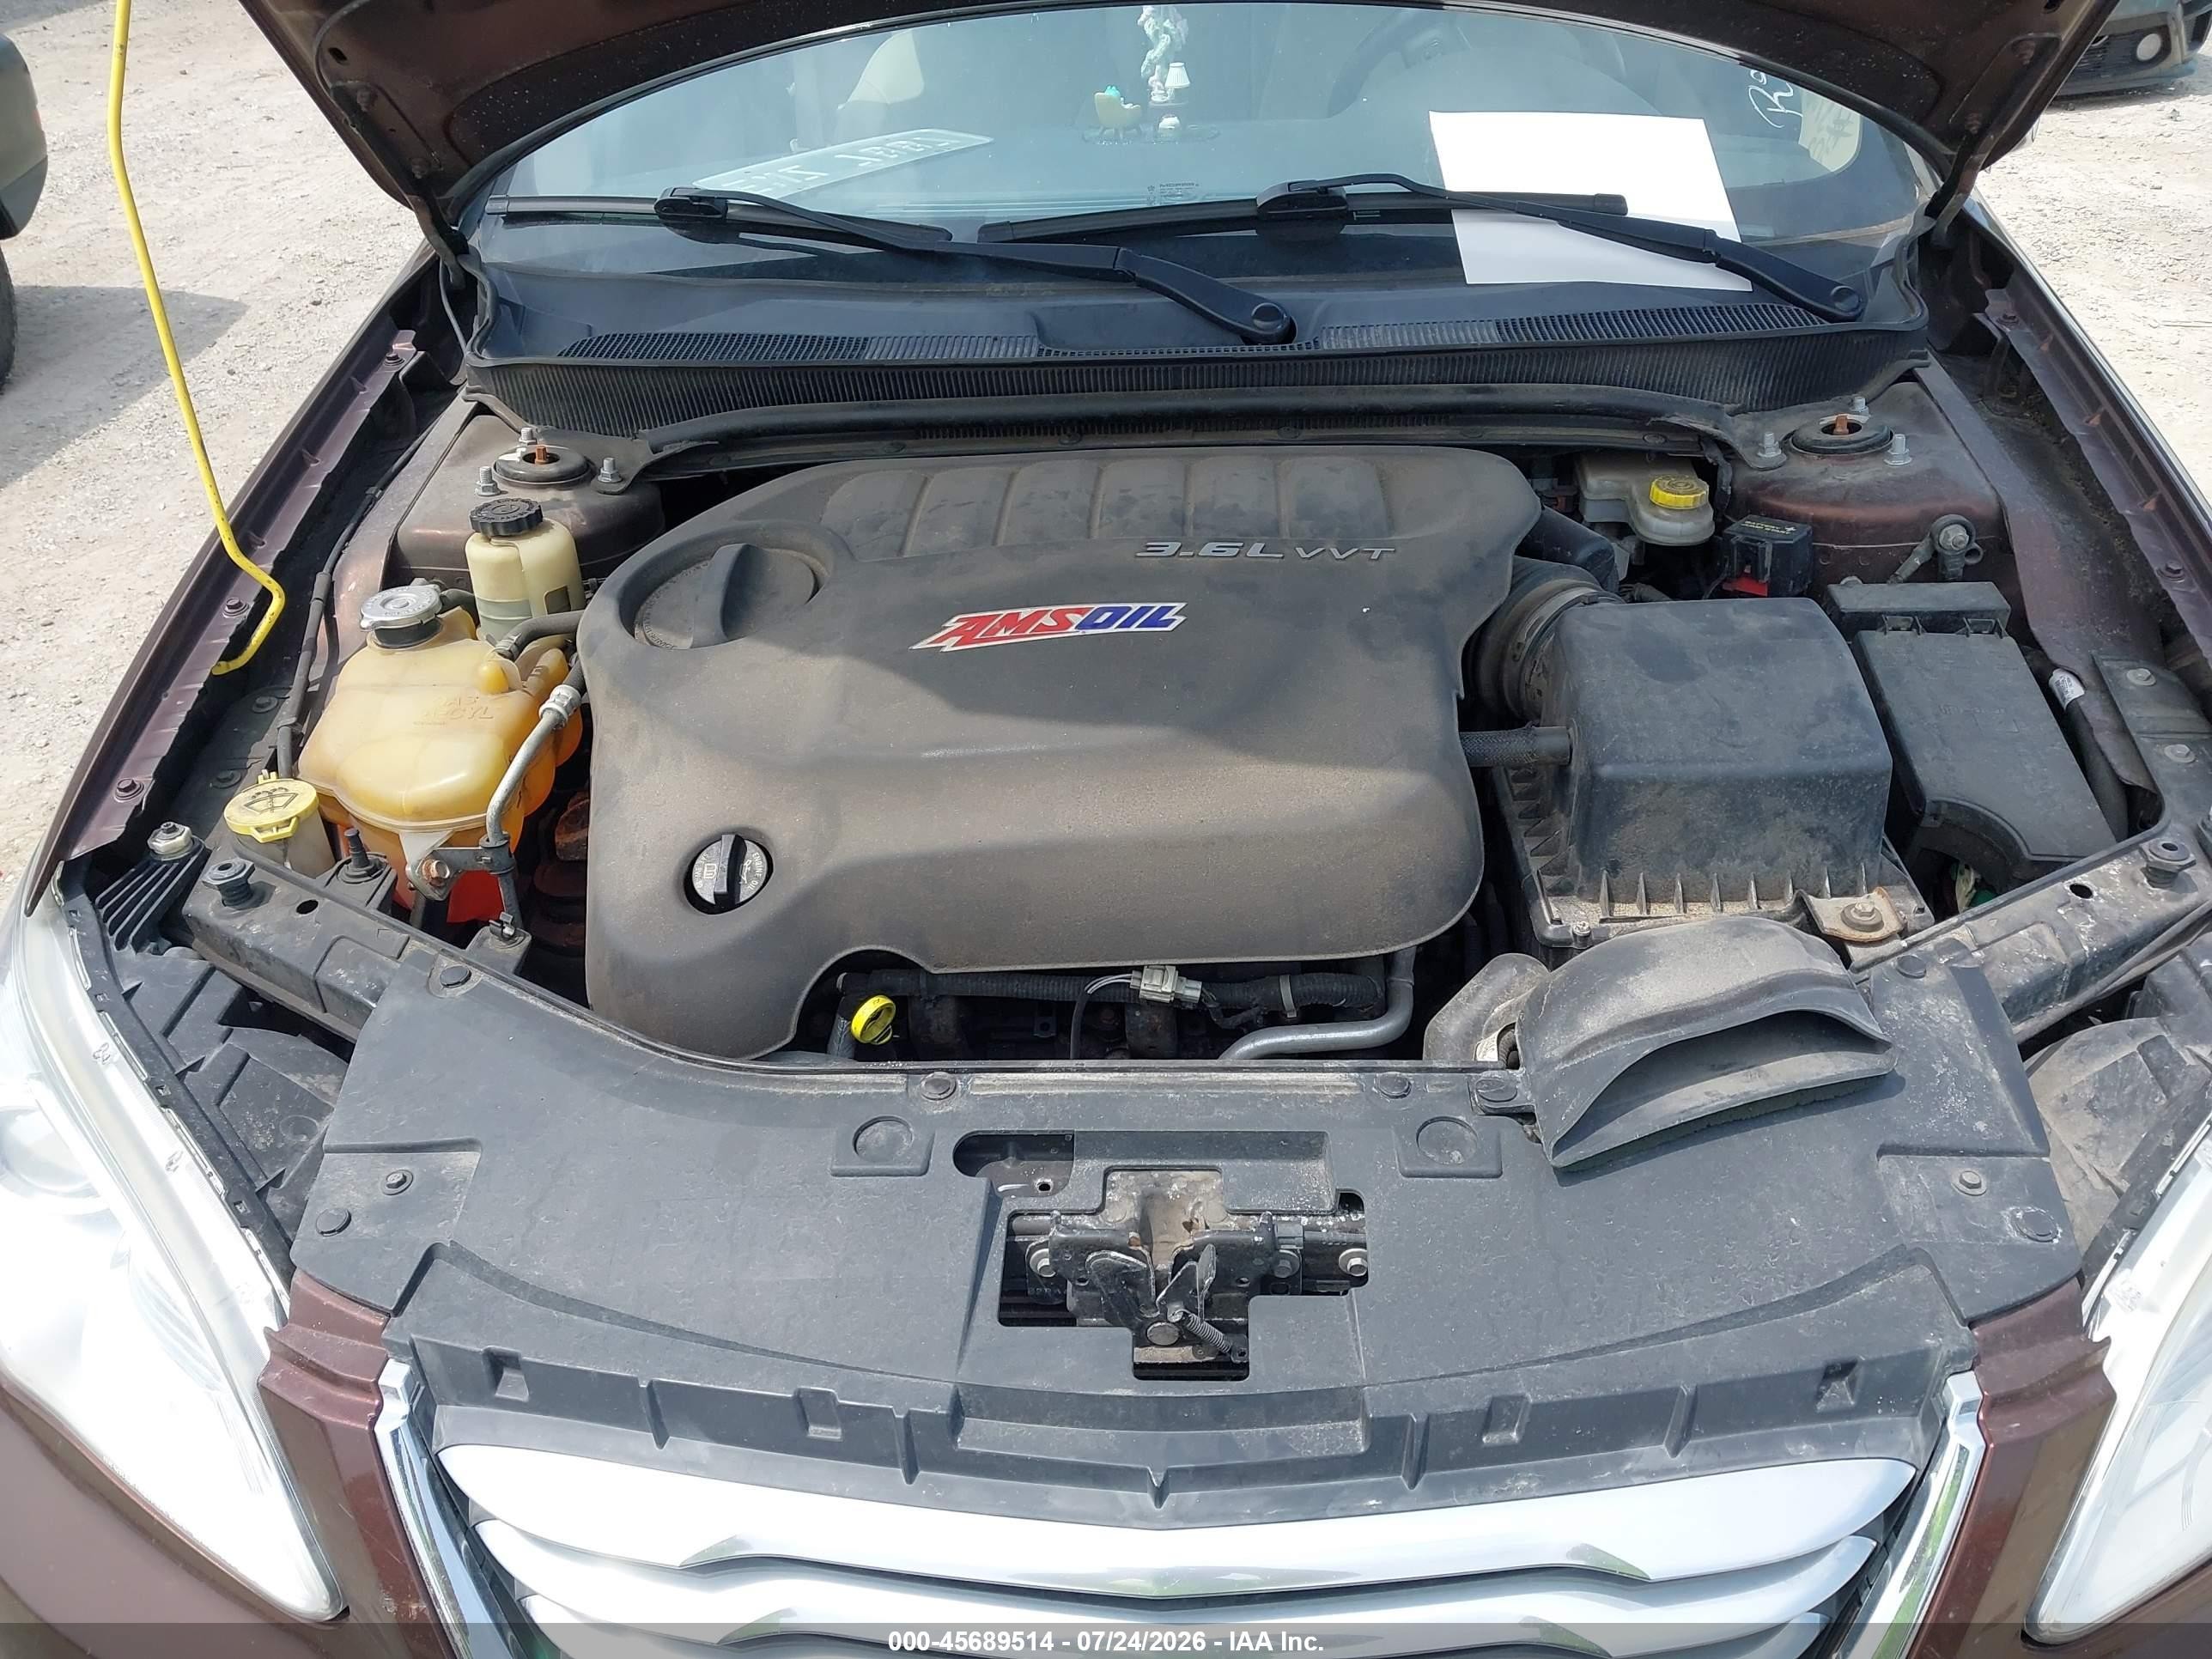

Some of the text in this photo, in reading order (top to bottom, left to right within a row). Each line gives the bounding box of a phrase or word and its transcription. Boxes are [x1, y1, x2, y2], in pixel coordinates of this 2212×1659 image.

[1134, 541, 1396, 560] 3.6L VVT
[927, 605, 1186, 647] AMSOIL
[747, 851, 763, 891] ENGINE OIL
